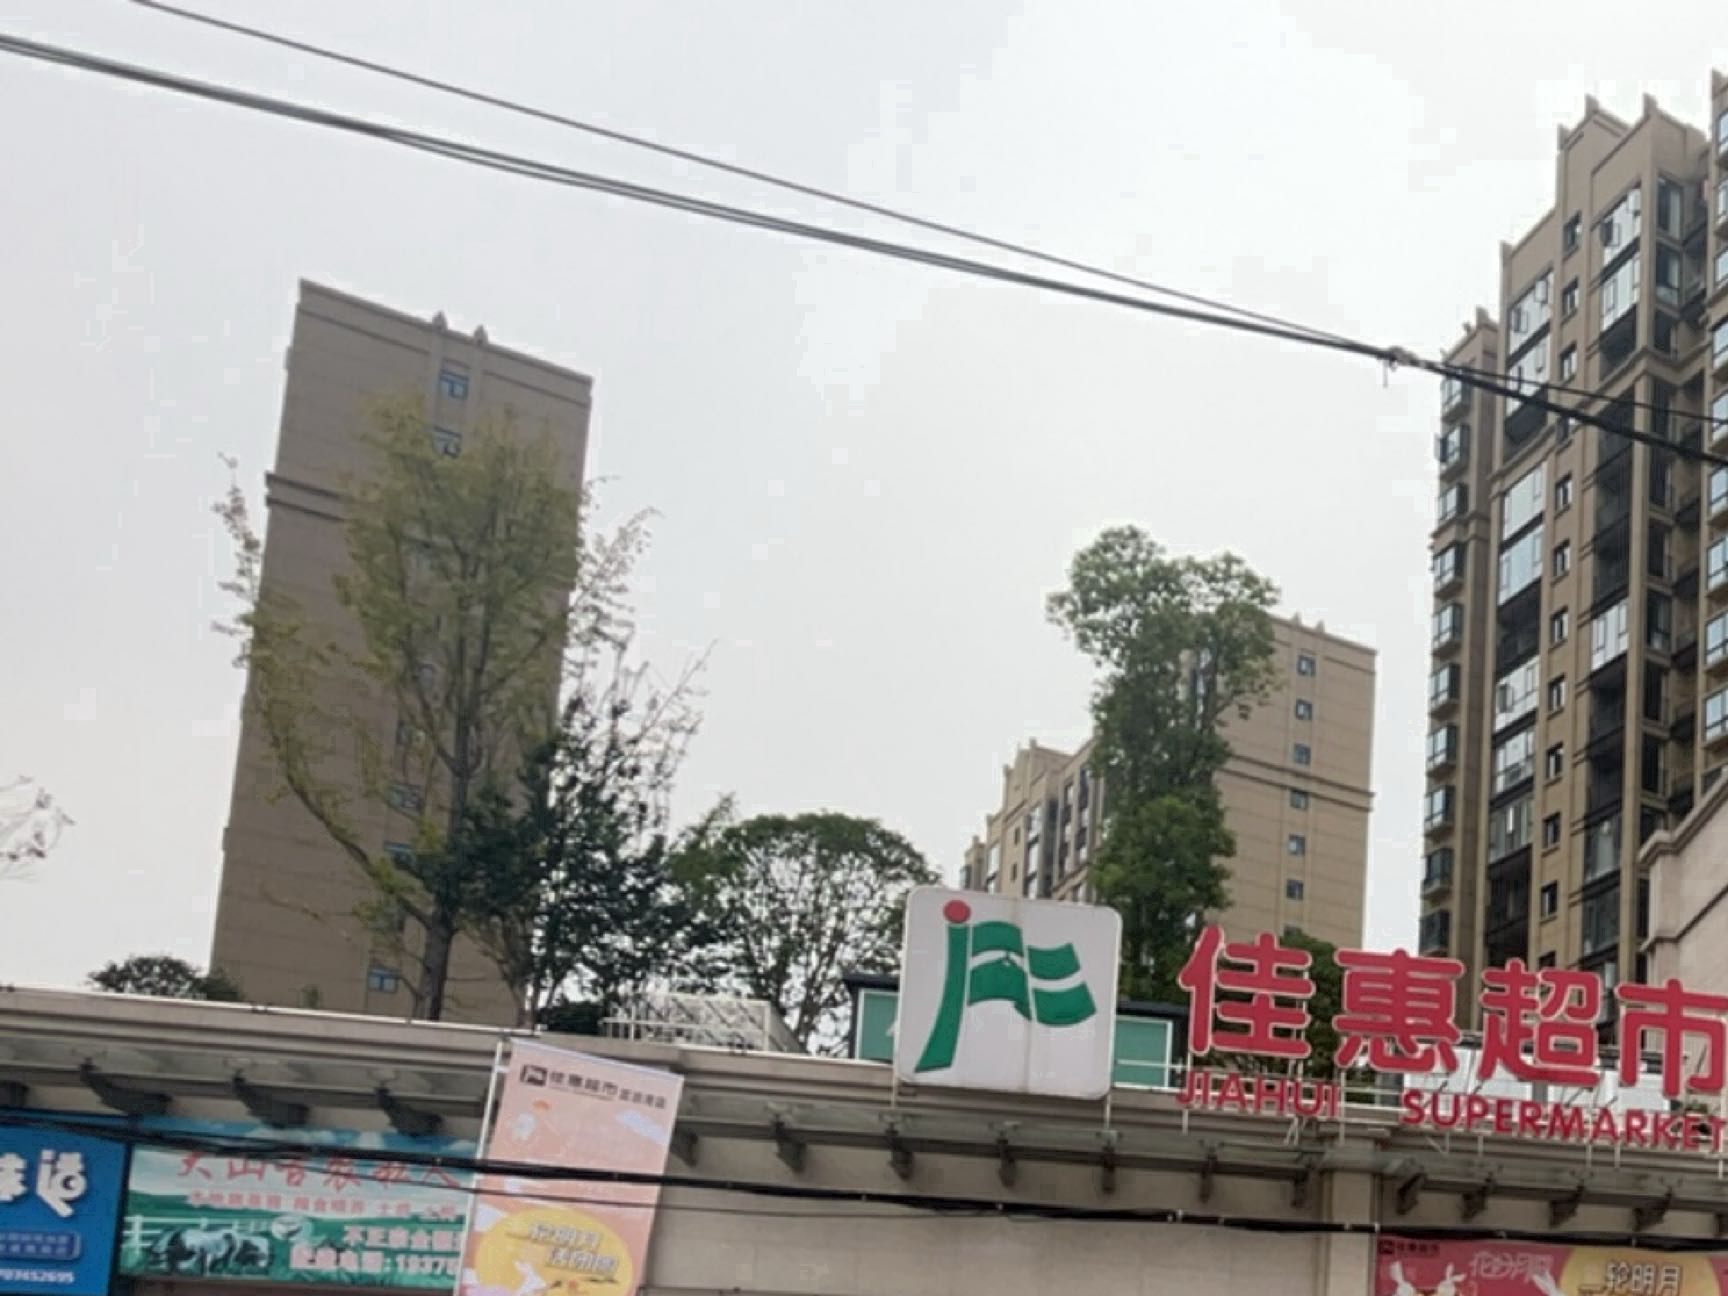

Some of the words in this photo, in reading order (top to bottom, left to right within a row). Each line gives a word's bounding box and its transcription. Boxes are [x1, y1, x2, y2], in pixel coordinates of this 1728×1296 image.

[1176, 1070, 1342, 1118] JIAHUI
[1402, 1089, 1728, 1152] SUPERMARKET
[1578, 1261, 1682, 1296] 一轮明月
